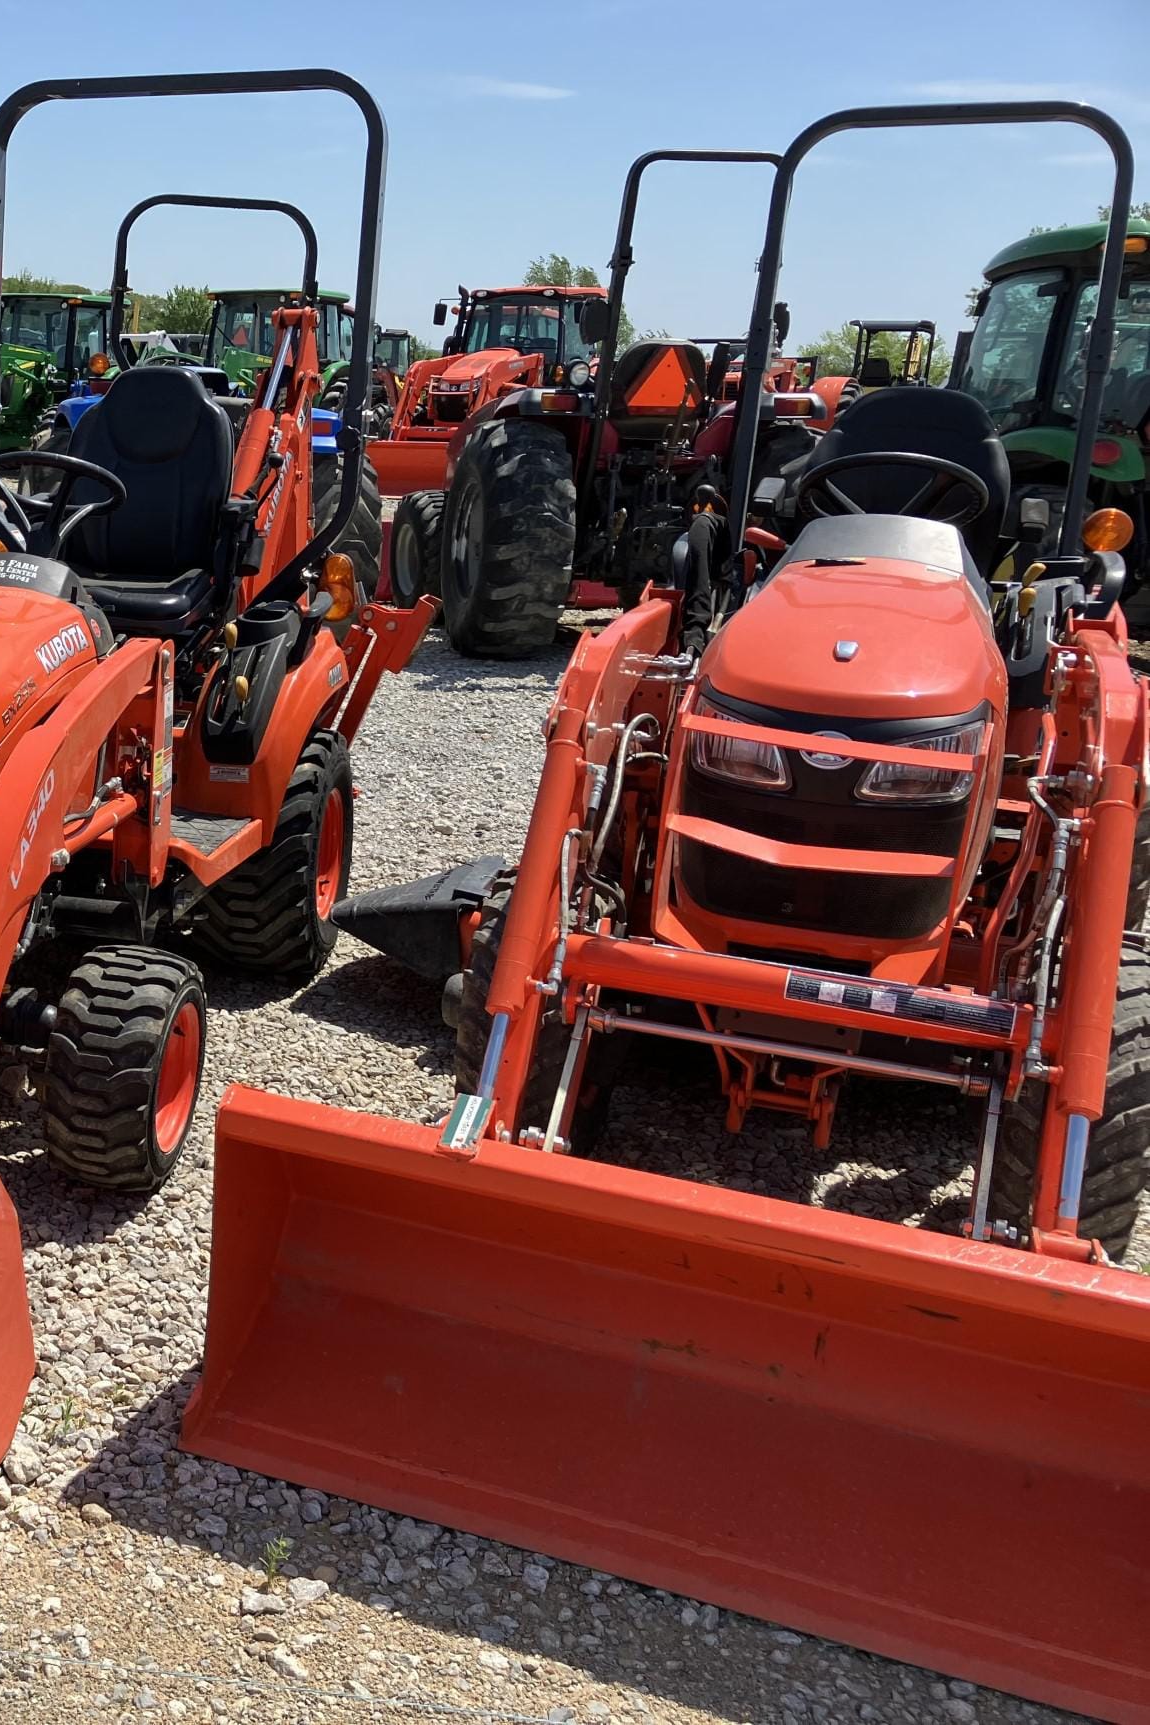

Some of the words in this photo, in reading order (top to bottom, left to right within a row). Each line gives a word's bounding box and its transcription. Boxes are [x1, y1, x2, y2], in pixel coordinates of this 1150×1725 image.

[263, 450, 292, 536] KUBOTA
[7, 559, 39, 572] FARM
[34, 621, 90, 675] KUBOTA
[10, 768, 55, 891] LA340
